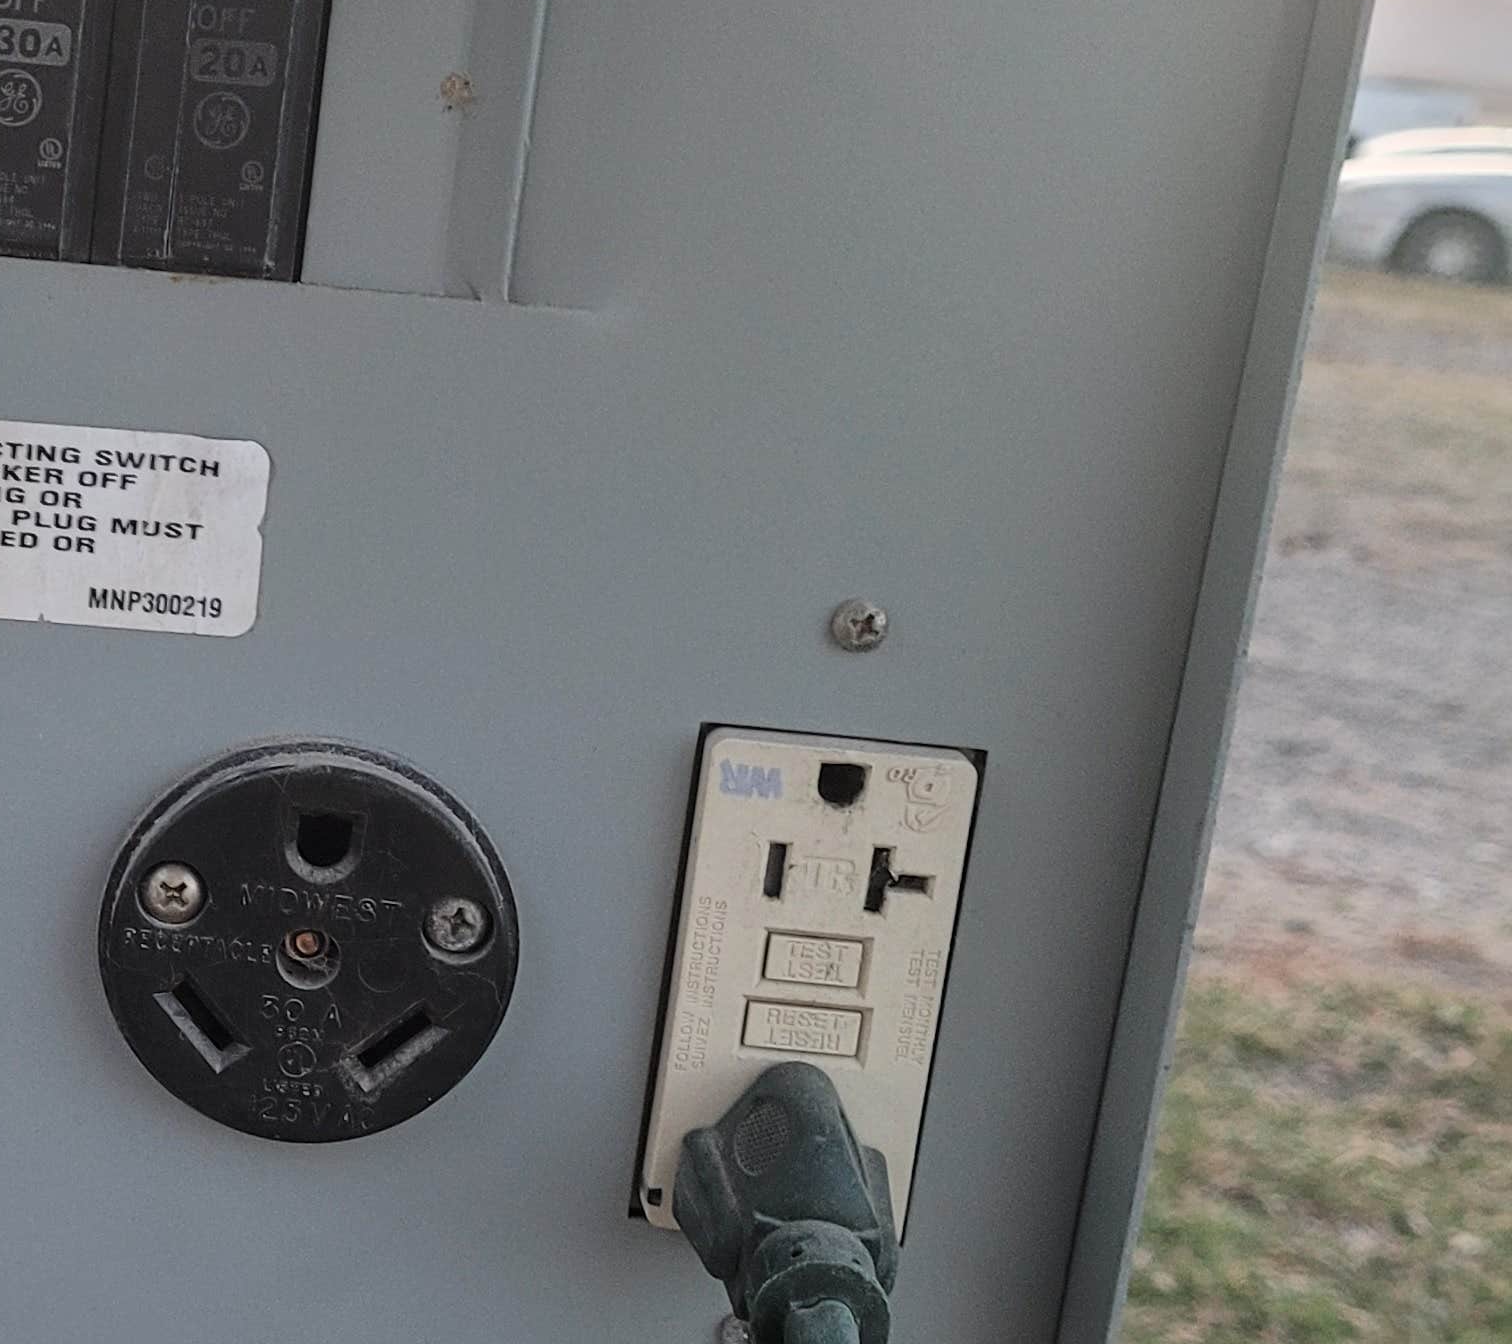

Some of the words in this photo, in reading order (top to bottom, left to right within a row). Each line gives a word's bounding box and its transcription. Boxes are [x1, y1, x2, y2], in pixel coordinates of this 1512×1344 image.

[196, 6, 255, 34] OFF
[196, 45, 268, 80] 20A
[95, 450, 220, 477] SWITCH
[78, 471, 137, 490] OFF
[40, 490, 82, 508] OR
[12, 510, 97, 532] PLUG
[111, 518, 204, 540] MUST
[53, 536, 95, 553] OR
[89, 587, 222, 618] MNP300219
[240, 882, 403, 923] MIDWEST
[788, 940, 850, 963] TEST
[907, 948, 925, 988] TEST
[924, 949, 942, 989] TEST
[675, 1011, 695, 1071] FOLLOW
[688, 896, 712, 1005] INSTRUCTIONS
[692, 1017, 710, 1069] SUIVEZ
[703, 900, 727, 1008] INSTRUCTIONS
[258, 993, 306, 1022] 30
[320, 1002, 343, 1030] A
[767, 1007, 845, 1030] RESET
